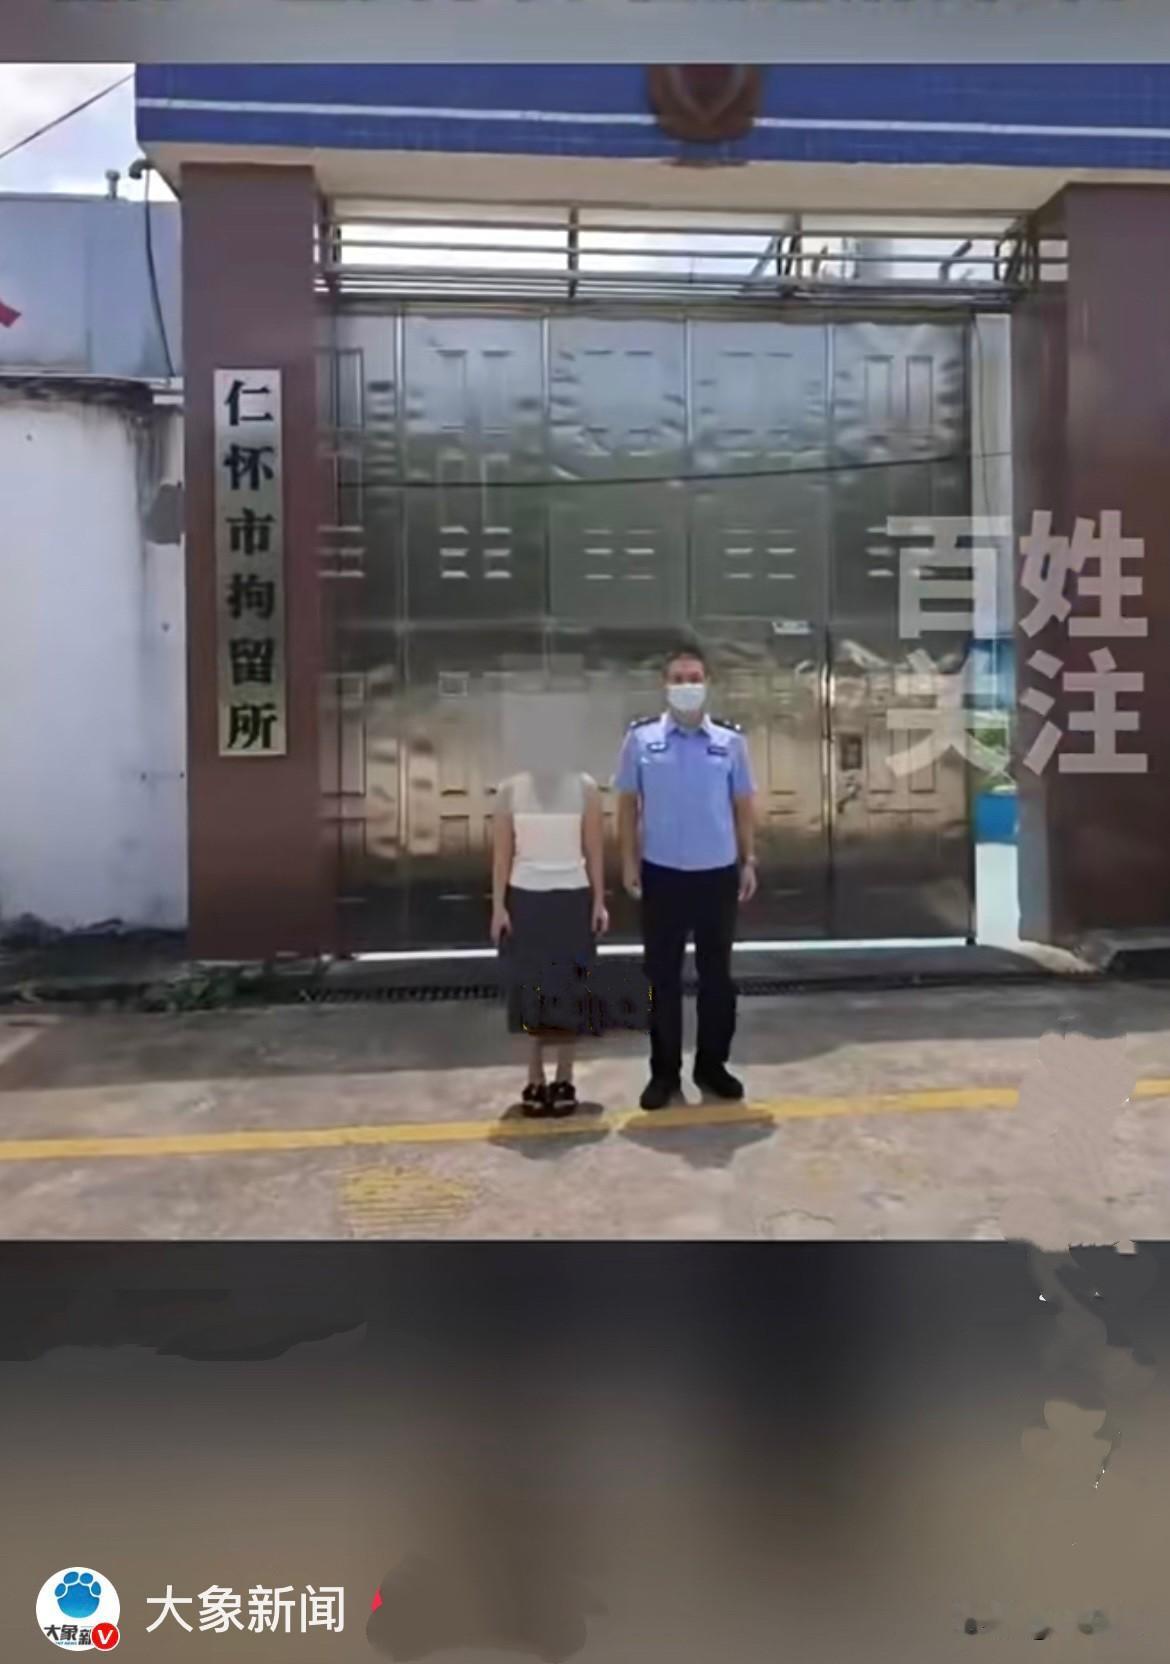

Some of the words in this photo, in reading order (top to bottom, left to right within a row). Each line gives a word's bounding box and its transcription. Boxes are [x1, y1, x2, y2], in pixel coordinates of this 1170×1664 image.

[223, 380, 278, 750] 仁怀市拘留所
